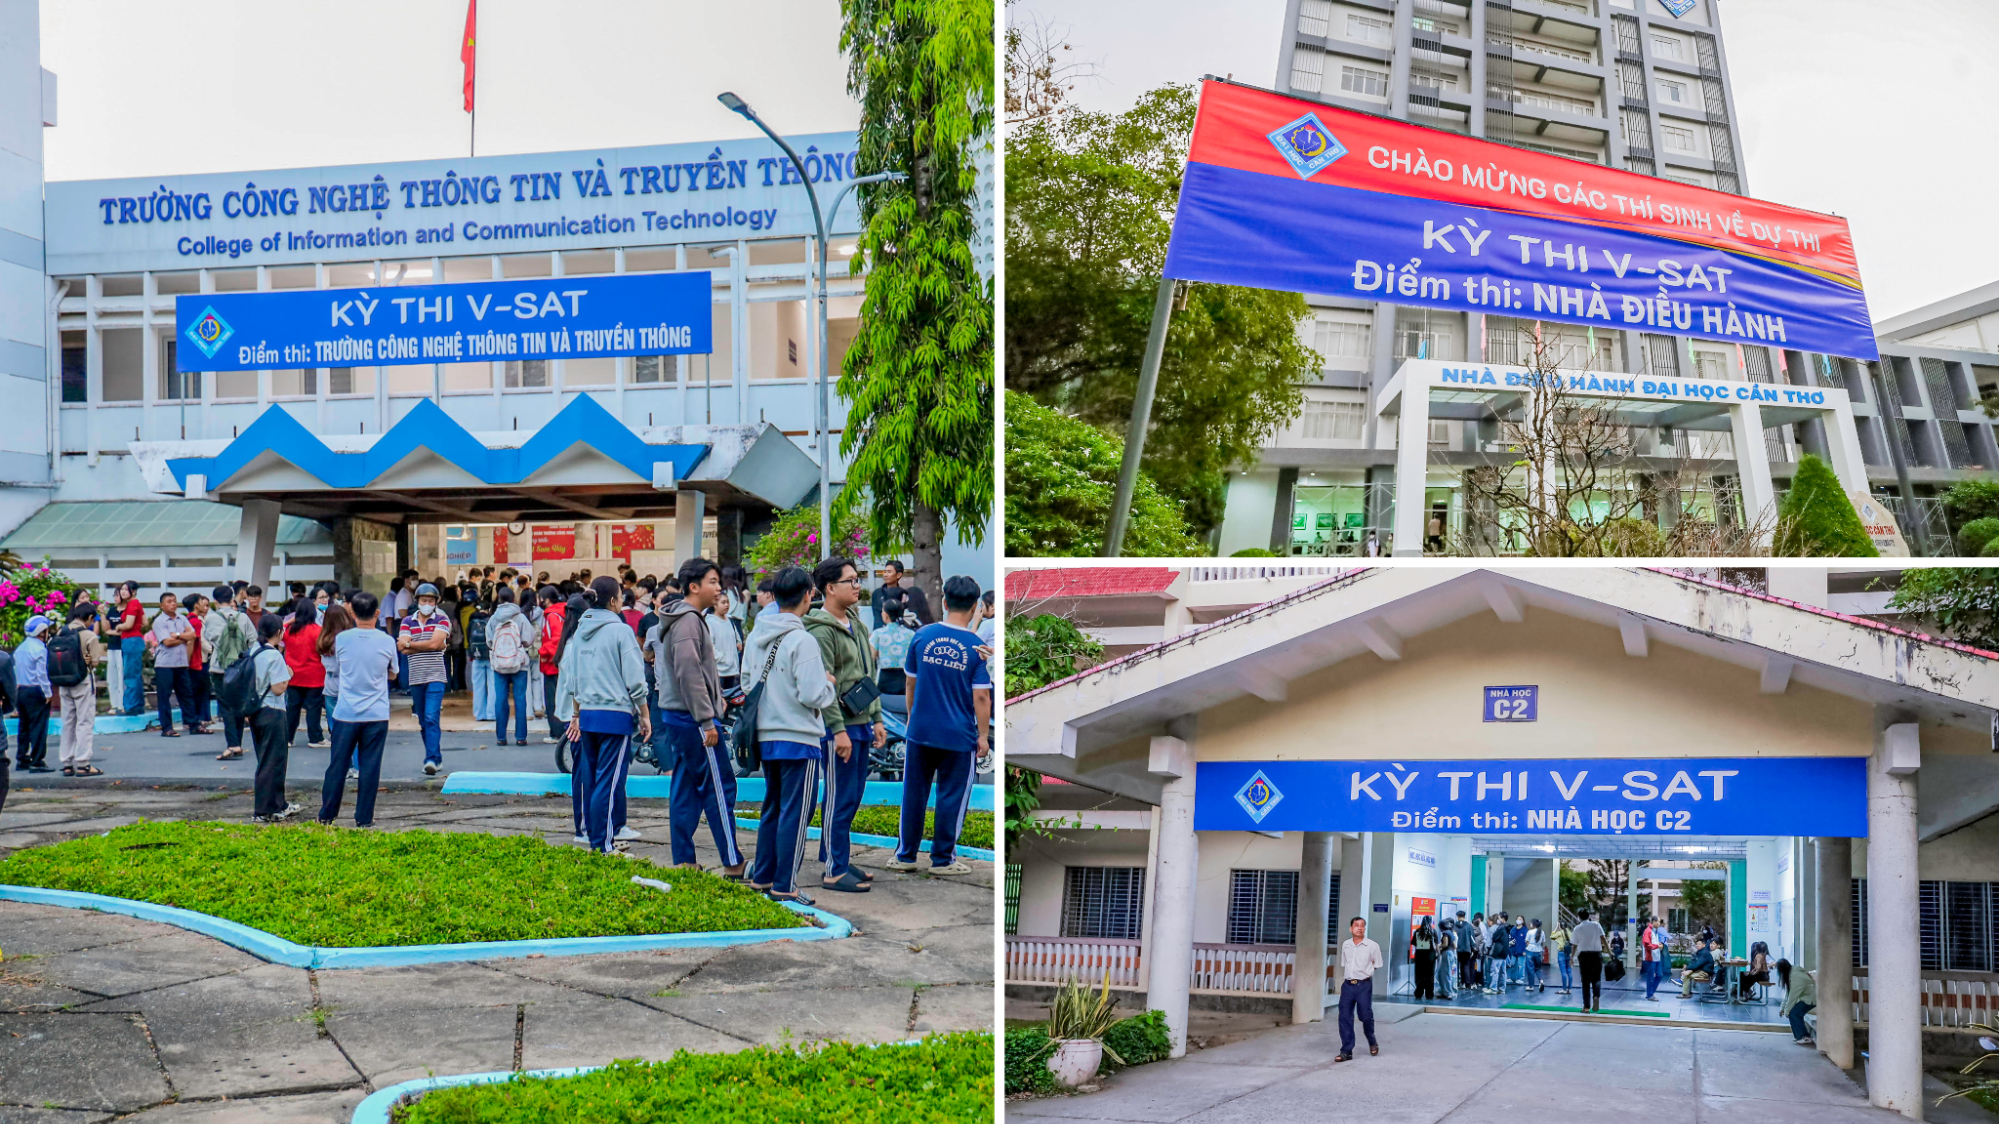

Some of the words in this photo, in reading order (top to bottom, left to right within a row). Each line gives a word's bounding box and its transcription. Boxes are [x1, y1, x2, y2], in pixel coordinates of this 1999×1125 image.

[99, 184, 212, 225] TRƯỜNG
[223, 181, 299, 218] CÔNG
[308, 174, 389, 220] NGHỆ
[400, 169, 500, 208] THÔNG
[510, 171, 561, 201] TIN
[572, 158, 612, 197] VÀ
[620, 146, 747, 195] TRUYỀN
[1368, 146, 1453, 181] CHÀO
[1462, 163, 1546, 199] MỪNG
[1553, 181, 1607, 210] CÁC
[1613, 194, 1653, 219] THÍ
[1660, 204, 1711, 231] SINH
[1717, 210, 1747, 238] VỀ
[1751, 222, 1781, 249] DỰ
[1787, 229, 1821, 253] THI
[177, 235, 253, 258] College
[260, 231, 282, 251] of
[288, 225, 407, 251] Information
[415, 222, 454, 243] and
[463, 213, 634, 241] Communication
[642, 205, 777, 241] Technology
[1422, 217, 1491, 257] KỲ
[1508, 234, 1589, 273] THI
[1602, 249, 1733, 294] V-SAT
[331, 291, 380, 327] KỲ
[391, 294, 453, 325] THI
[466, 290, 588, 322] V-SAT
[1351, 257, 1450, 301] Điểm
[1463, 275, 1522, 309] thi:
[1533, 281, 1611, 321] NHÀ
[1621, 287, 1691, 330] ĐIỀU
[1703, 302, 1787, 343] HÀNH
[238, 339, 279, 366] Điểm
[284, 344, 311, 364] thi:
[315, 336, 373, 362] TRƯỜNG
[377, 333, 419, 360] CÔNG
[423, 330, 462, 363] NGHỆ
[466, 328, 519, 358] THÔNG
[522, 331, 546, 354] TIN
[549, 325, 571, 353] VÀ
[574, 321, 636, 352] TRUYỀN
[639, 320, 692, 349] THÔNG
[1442, 367, 1496, 385] NHÀ
[1570, 373, 1635, 393] HÀNH
[1643, 381, 1677, 399] ĐẠI
[1684, 384, 1729, 401] HỌC
[1783, 390, 1825, 405] THƠ
[1490, 687, 1510, 698] NHÀ
[1512, 688, 1531, 699] HỌC
[1493, 699, 1528, 719] C2
[1350, 763, 1420, 801] KỲ
[1437, 771, 1528, 801] THI
[1550, 770, 1739, 801] V-SAT
[1391, 807, 1461, 829] Điểm
[1471, 811, 1517, 829] thi:
[1527, 806, 1582, 830] NHÀ
[1591, 809, 1646, 834] HỌC
[1655, 809, 1691, 831] C2
